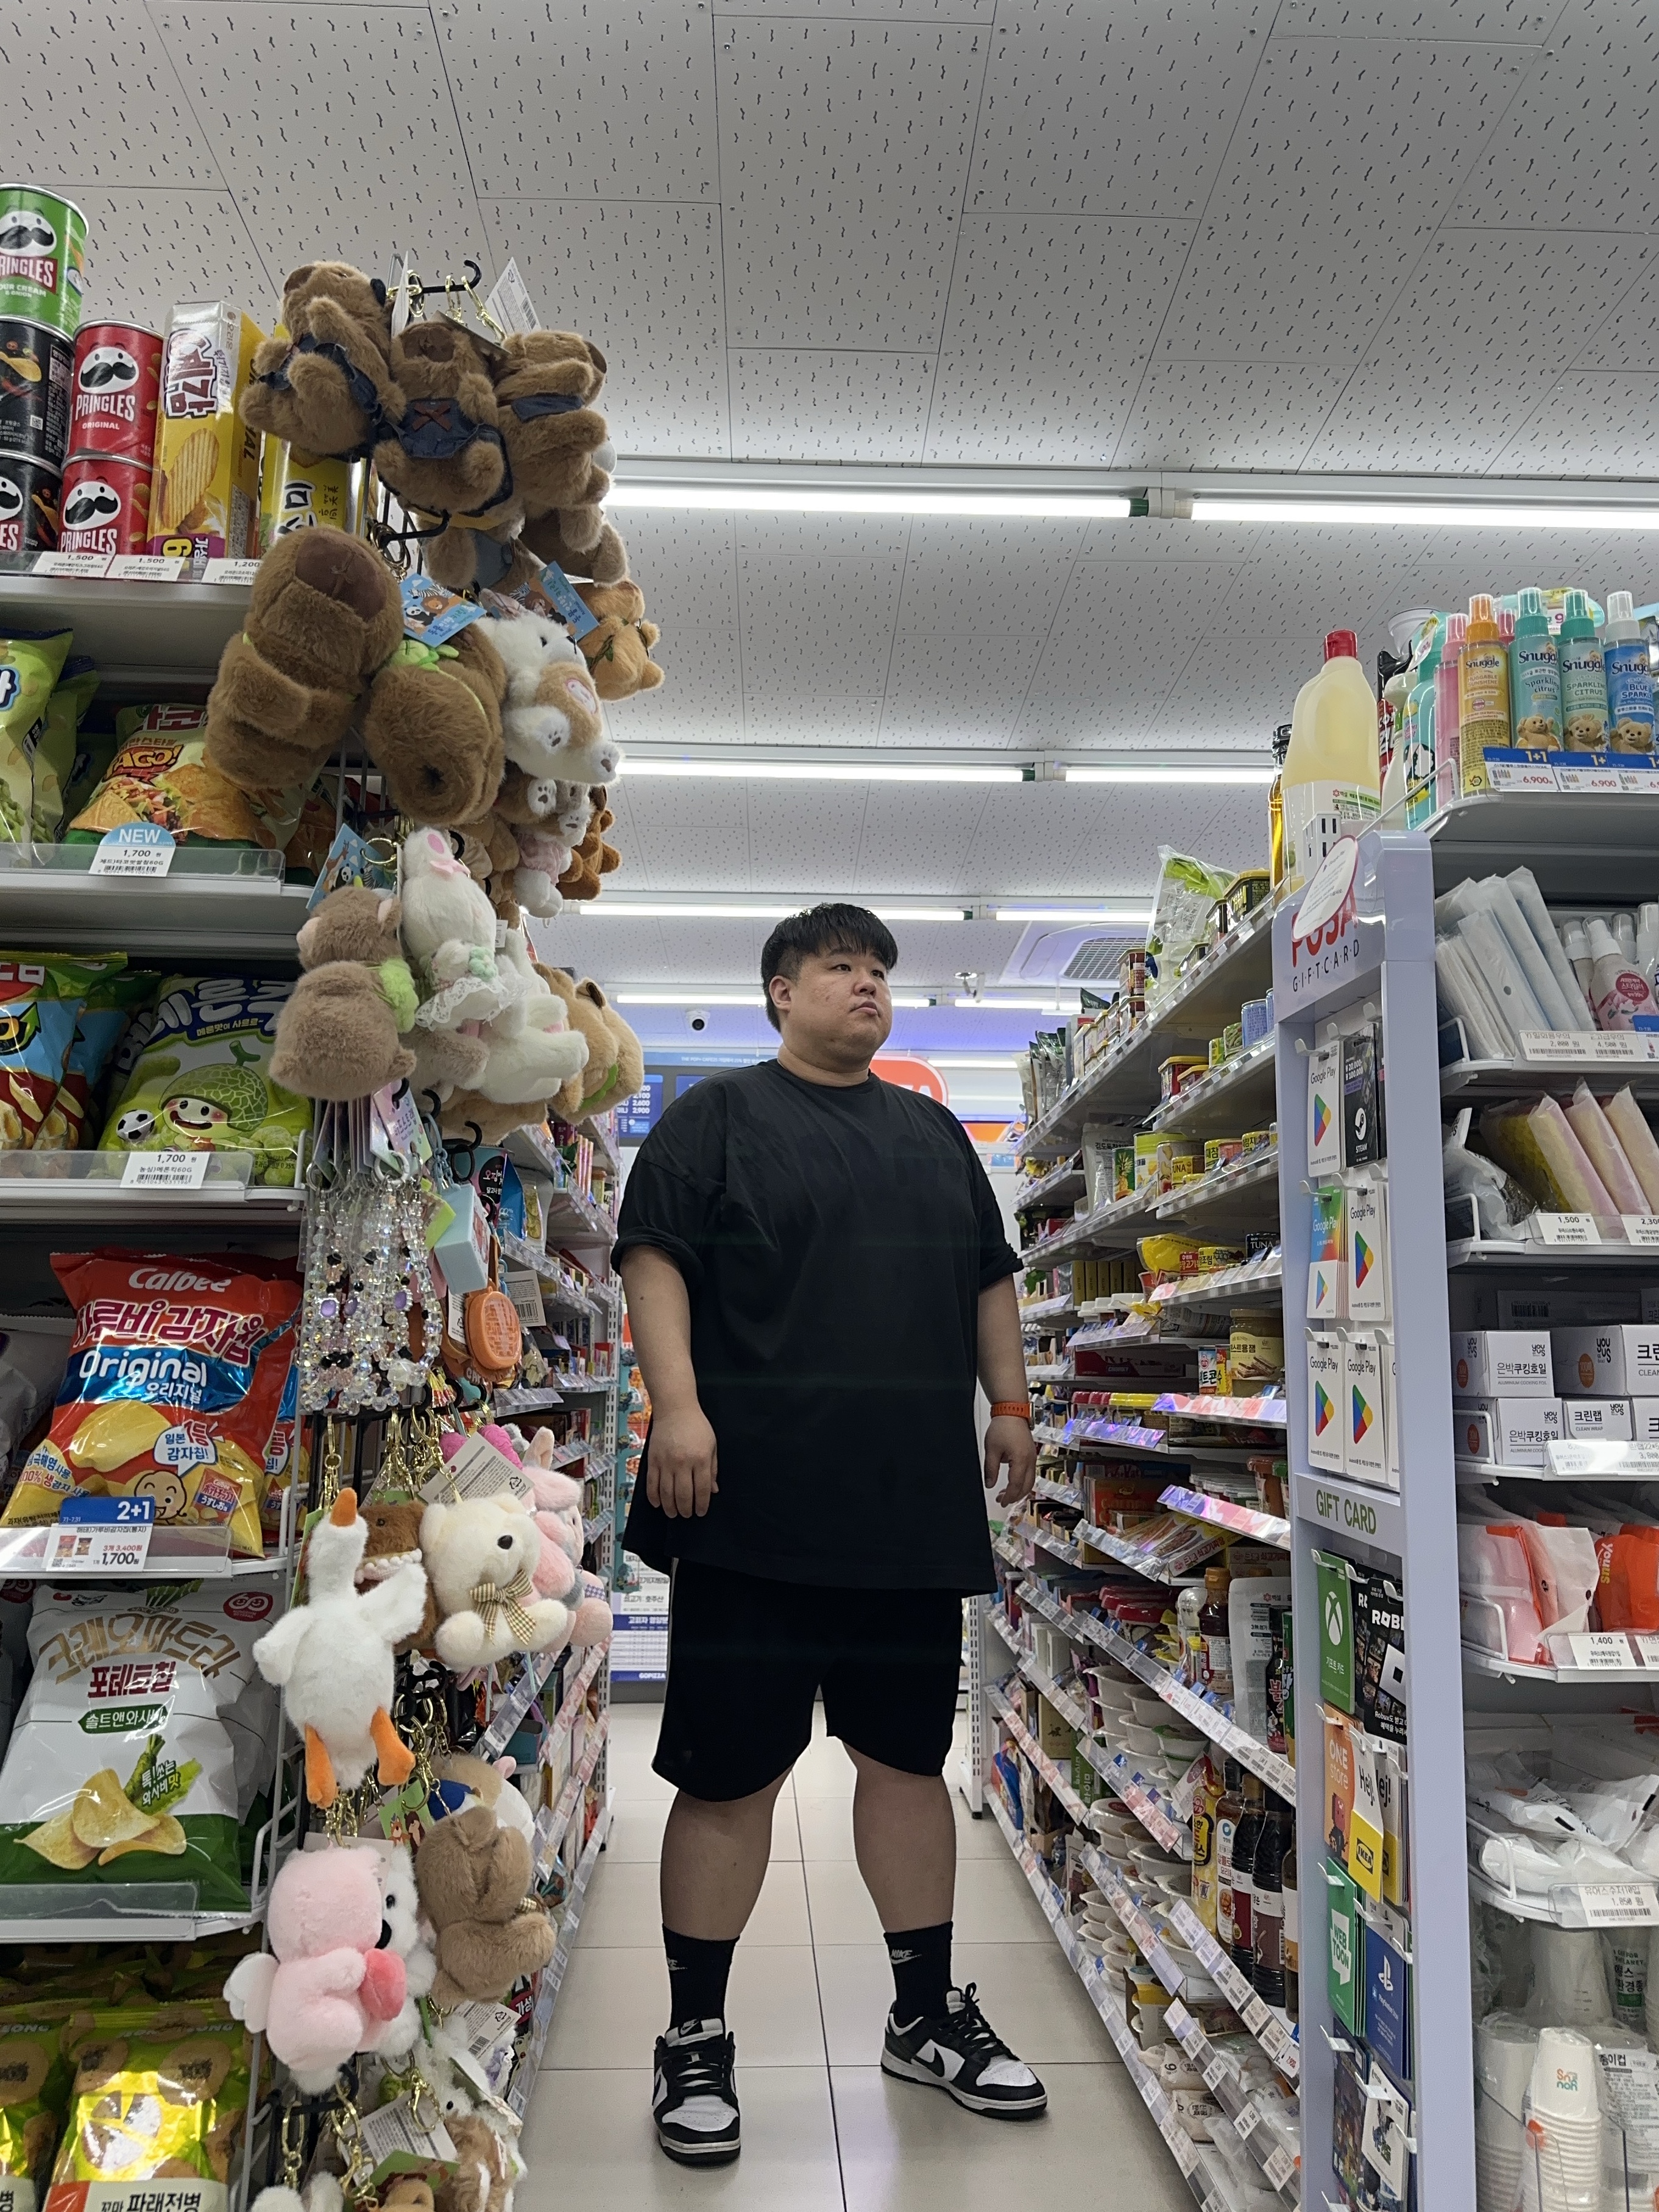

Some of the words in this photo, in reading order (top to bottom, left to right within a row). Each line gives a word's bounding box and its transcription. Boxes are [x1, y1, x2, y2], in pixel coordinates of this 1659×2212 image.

[76, 395, 135, 422] PRINGLES
[82, 421, 120, 430] ORIGINAL
[61, 528, 117, 556] PRINGLES
[1466, 659, 1499, 670] Snuggle
[1525, 677, 1560, 690] Sparkling
[118, 744, 183, 768] ACO!
[1525, 751, 1548, 762] 1+1
[1591, 755, 1607, 766] 1+
[118, 829, 160, 844] NEW
[1311, 1070, 1326, 1084] Google
[1327, 1067, 1337, 1080] Play
[1356, 1143, 1368, 1153] STEAM
[157, 1154, 185, 1164] 1,700
[1351, 1207, 1366, 1221] Google
[1367, 1204, 1376, 1219] Play
[1314, 1218, 1329, 1235] Google
[1329, 1217, 1339, 1231] Play
[1250, 1241, 1273, 1249] TUNA
[129, 1268, 232, 1293] Calbee
[79, 1350, 207, 1387] Original
[1311, 1356, 1327, 1372] Google
[1328, 1358, 1339, 1374] Play
[1348, 1359, 1365, 1376] Google
[1365, 1360, 1376, 1377] Play
[1496, 1362, 1546, 1376] 은박쿠킹호일
[146, 1381, 203, 1405] 오리지널
[1574, 1410, 1602, 1422] 크린랩
[165, 1433, 186, 1445] 일본
[167, 1447, 209, 1460] 감자칩!
[20, 1470, 43, 1483] 00%
[117, 1500, 150, 1521] 2+1
[1316, 1489, 1339, 1522] GIFT
[1344, 1498, 1377, 1535] CARD
[38, 1613, 241, 1686] 크레오파트라
[1591, 1637, 1613, 1645] 1,400
[88, 1661, 177, 1700] 포테토칩
[1329, 1739, 1348, 1770] ONE
[1330, 1763, 1349, 1790] store
[1359, 1765, 1375, 1806] Hej!
[1357, 1845, 1372, 1866] IKEA
[1333, 1923, 1347, 1950] WEB
[1332, 1940, 1349, 1970] TOON
[127, 2191, 202, 2212] 파래전병
